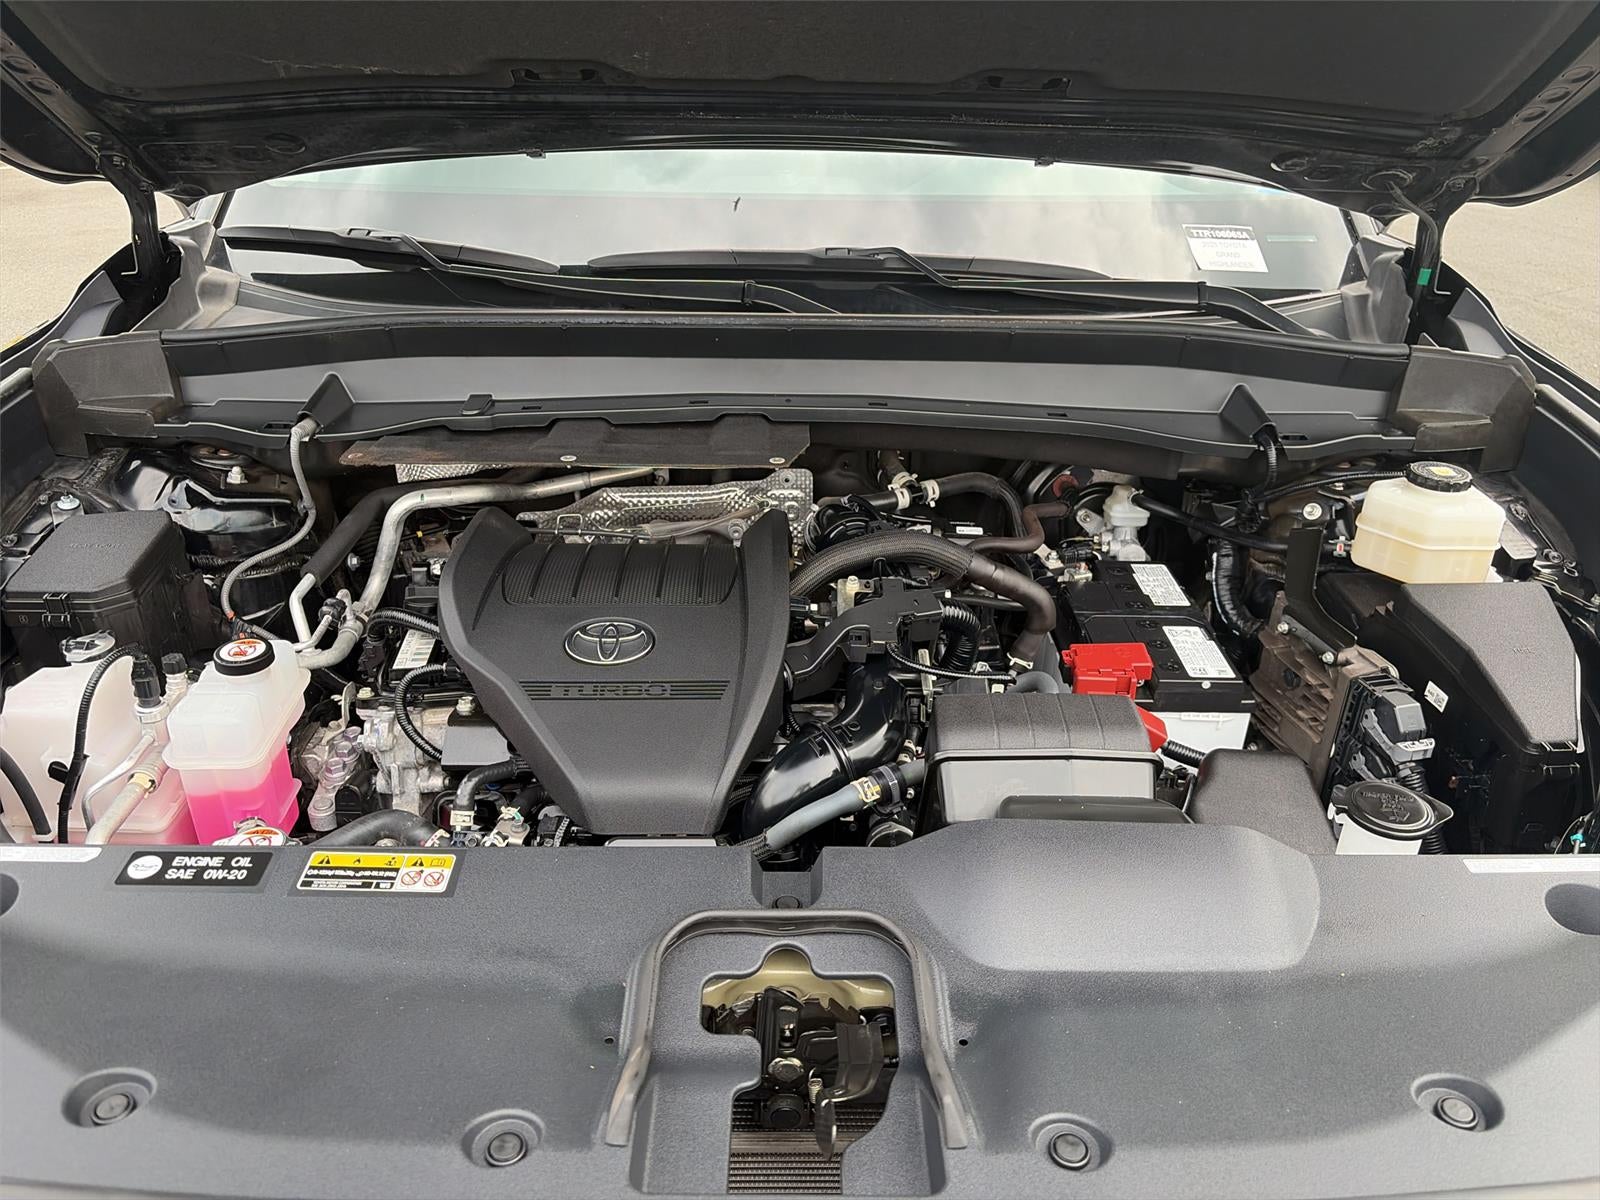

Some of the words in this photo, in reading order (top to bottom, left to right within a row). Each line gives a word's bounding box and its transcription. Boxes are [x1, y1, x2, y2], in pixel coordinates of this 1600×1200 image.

[555, 684, 669, 697] TURBO
[172, 856, 225, 867] ENGINE
[231, 856, 253, 867] OIL
[165, 869, 195, 880] SAE
[203, 869, 248, 880] 0W-20
